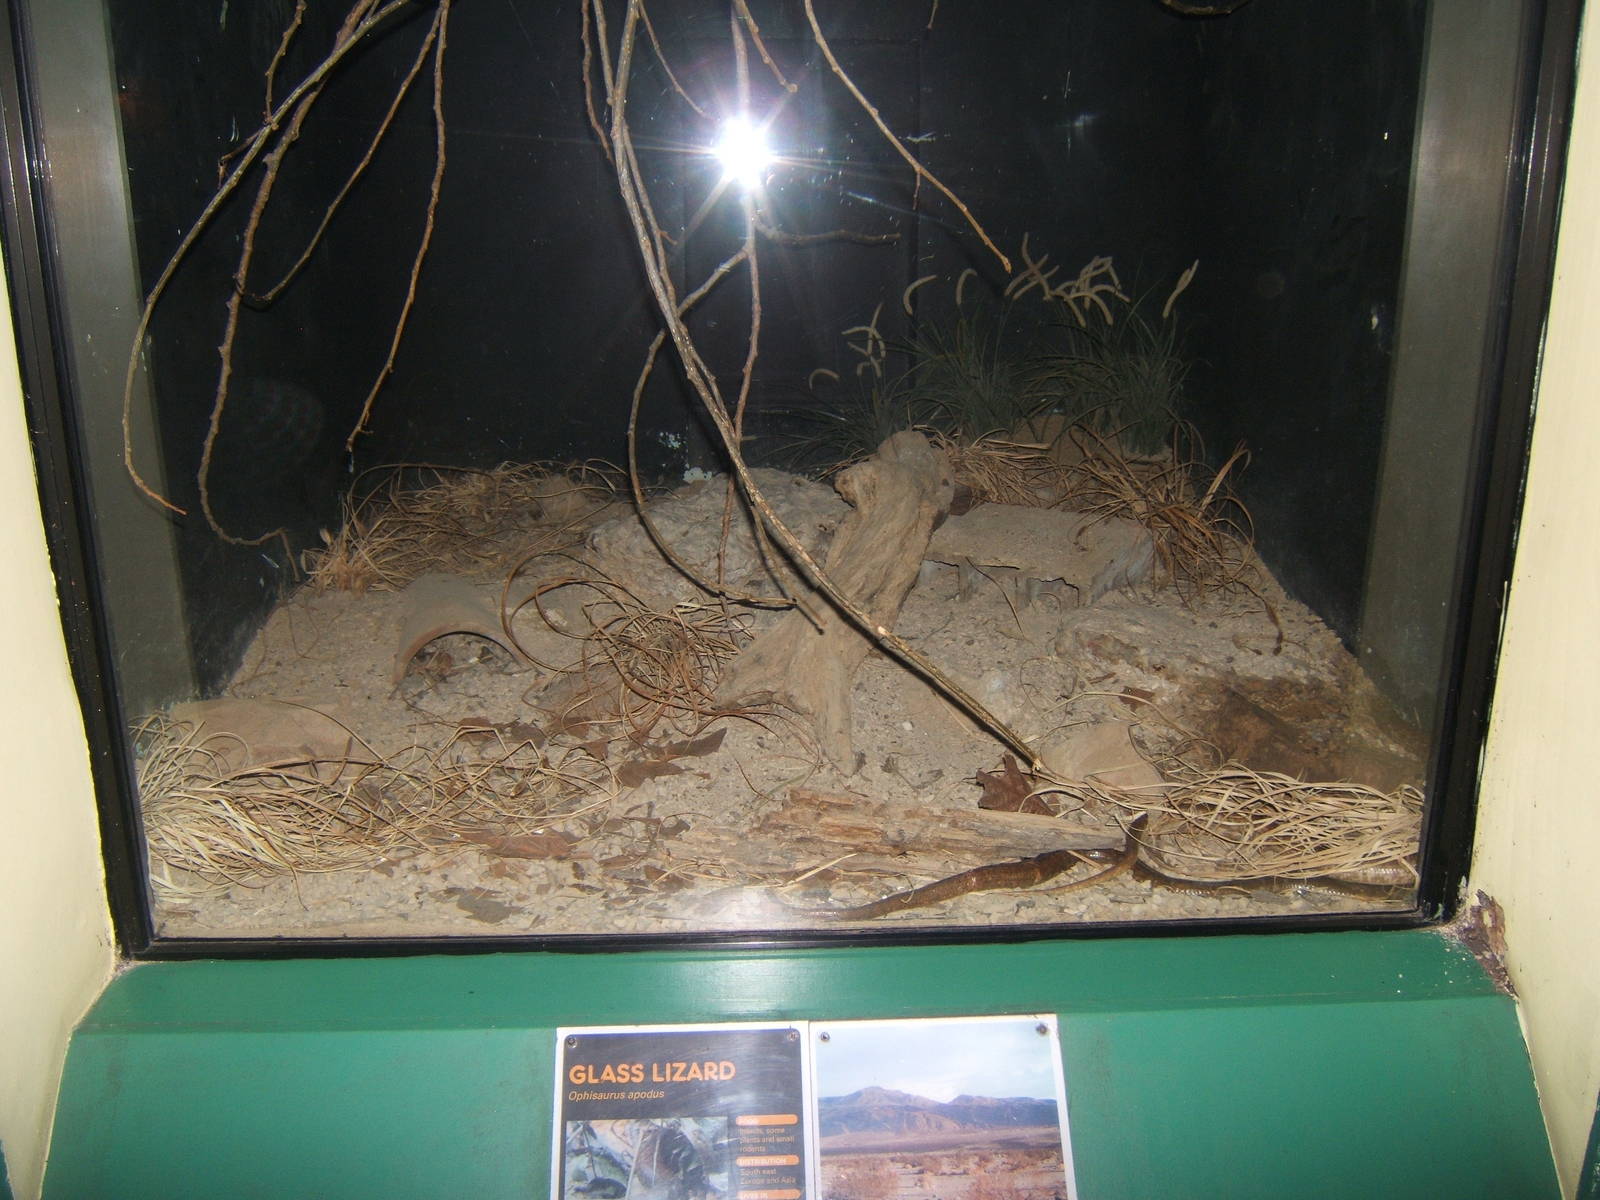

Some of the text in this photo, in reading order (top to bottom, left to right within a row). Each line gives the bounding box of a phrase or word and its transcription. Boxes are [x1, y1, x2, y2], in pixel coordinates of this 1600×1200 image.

[569, 1060, 736, 1085] GLASS LIZARD
[568, 1089, 665, 1102] Ophisaurus apodus
